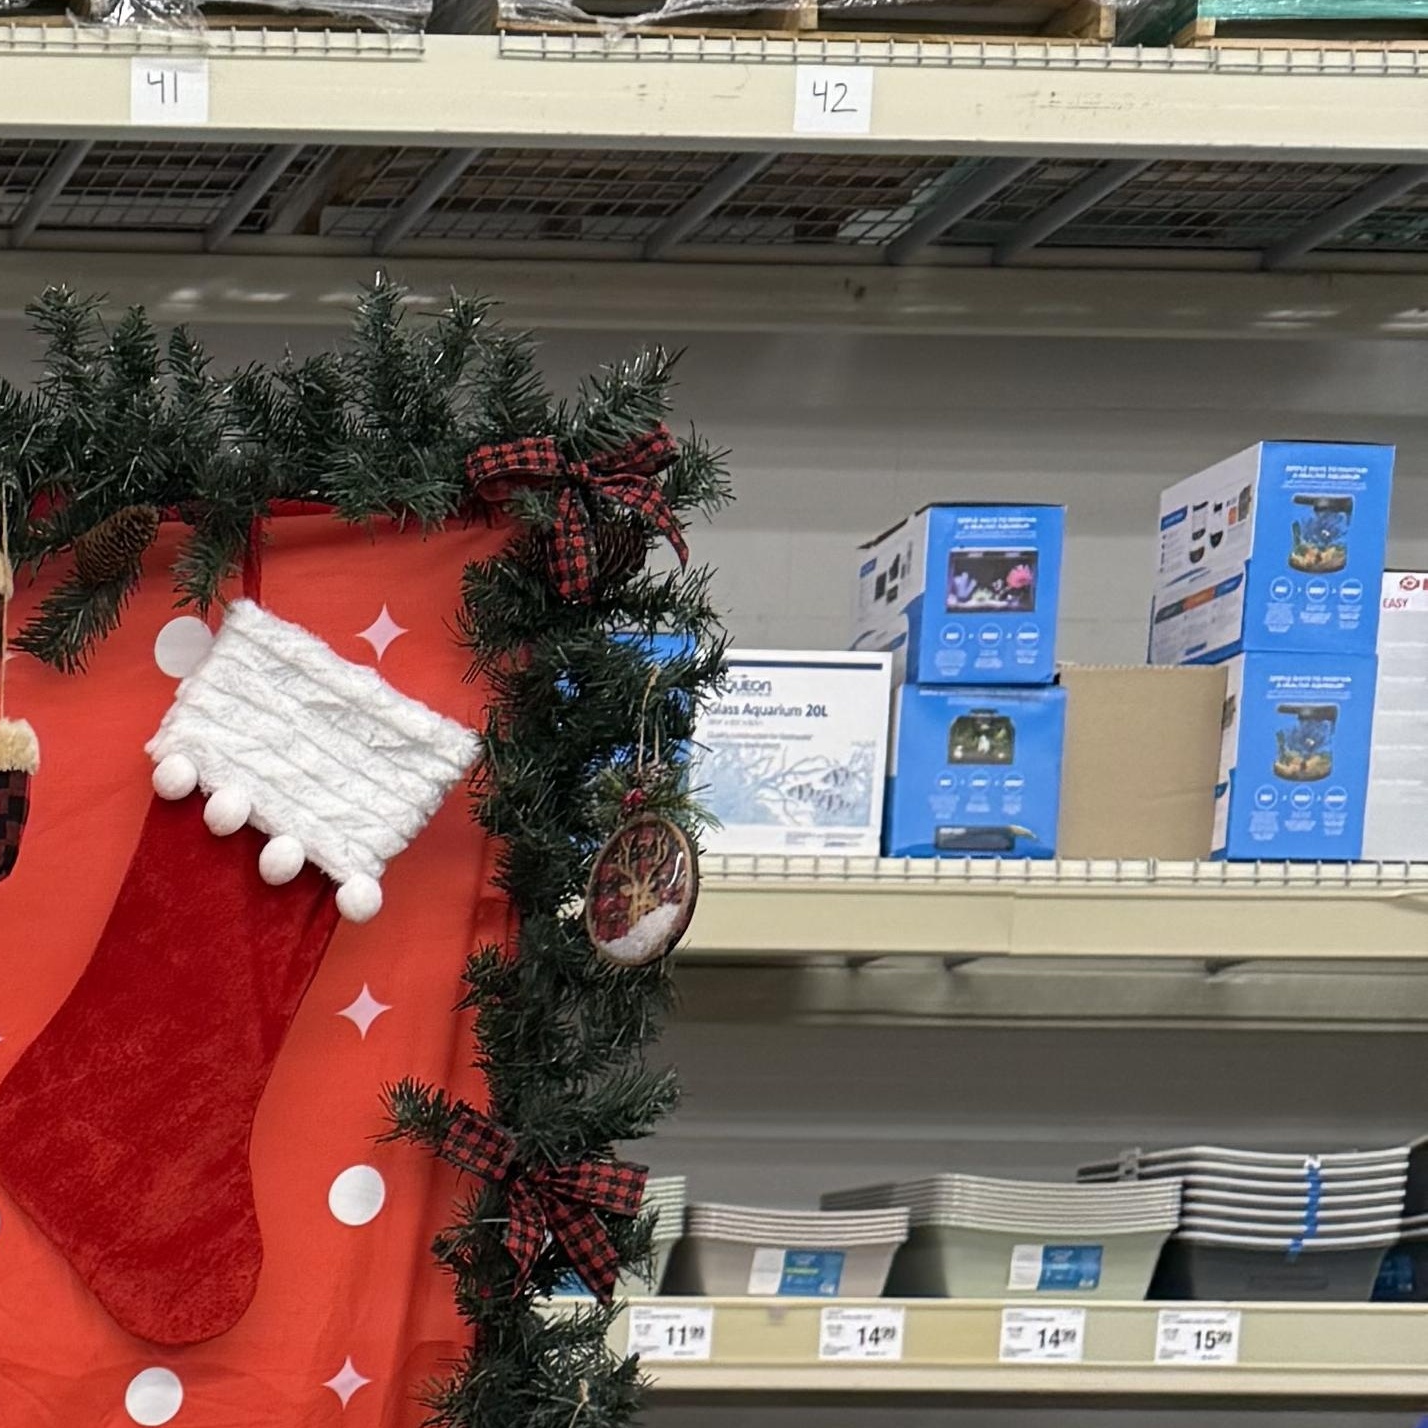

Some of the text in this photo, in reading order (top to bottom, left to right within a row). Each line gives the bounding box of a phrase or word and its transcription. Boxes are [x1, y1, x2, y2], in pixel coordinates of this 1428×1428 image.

[146, 70, 178, 104] 41
[812, 78, 858, 114] 42
[743, 703, 803, 718] Aquarium
[805, 703, 828, 717] 20L
